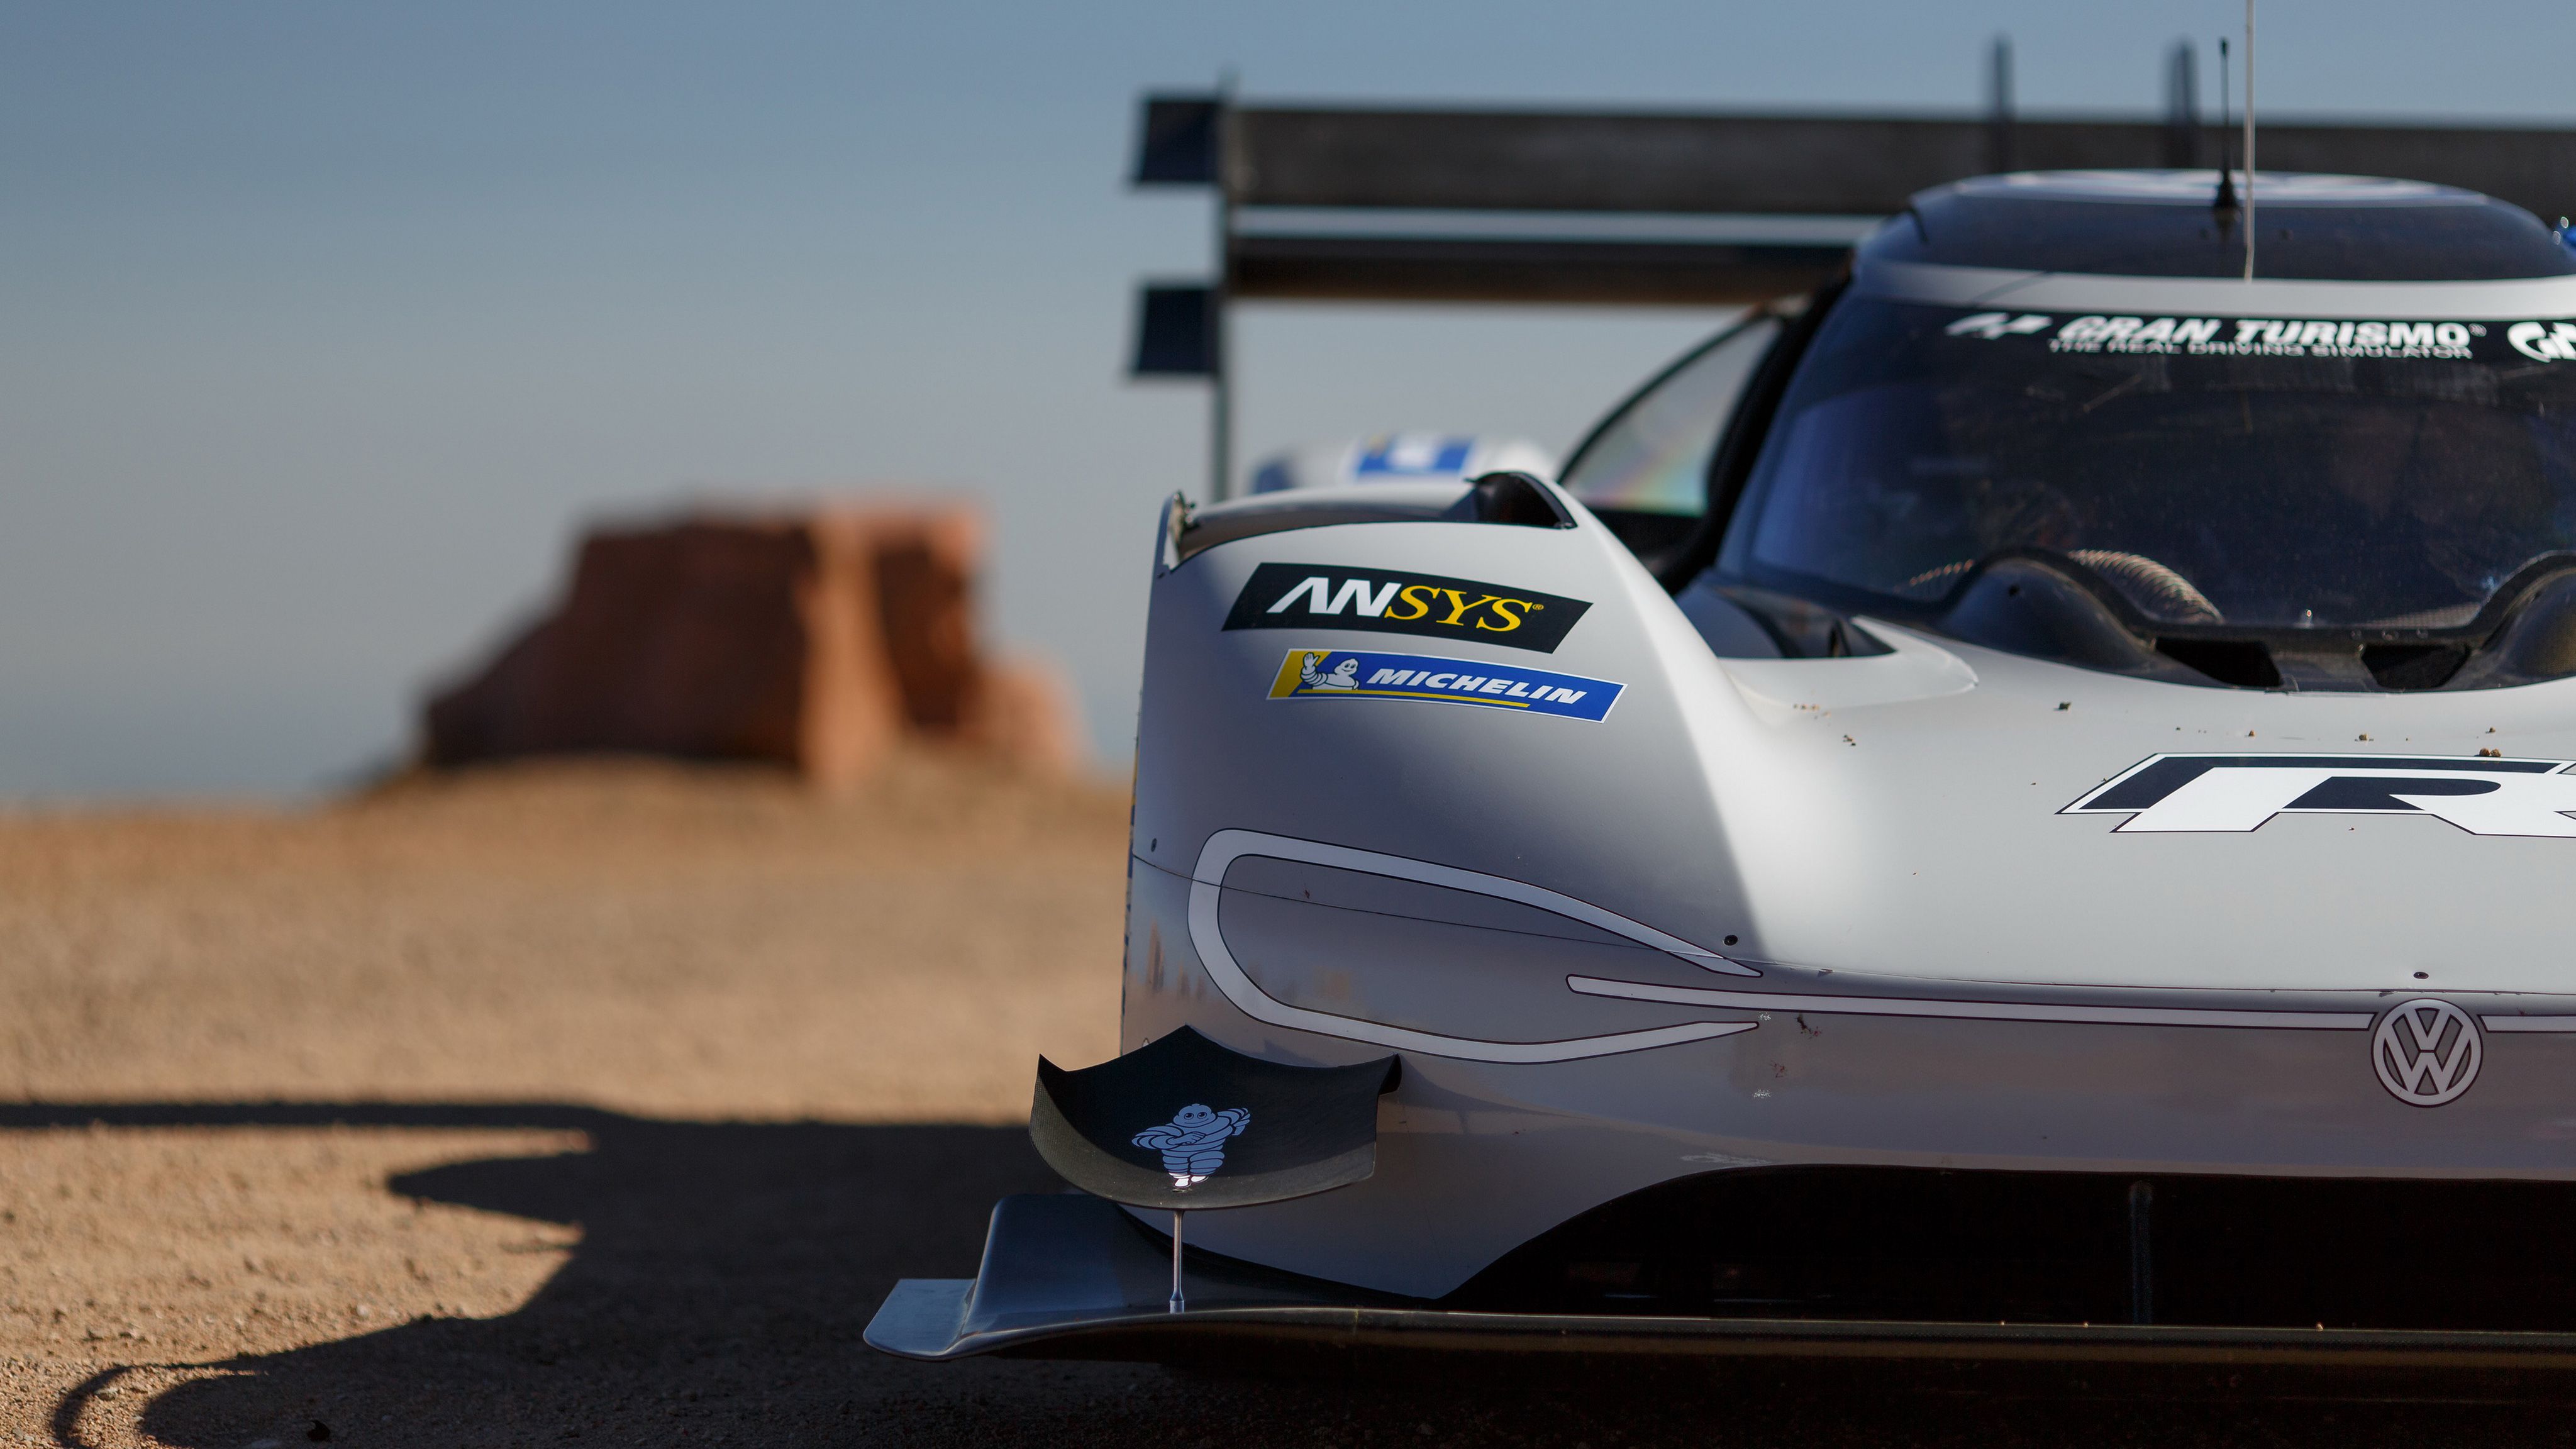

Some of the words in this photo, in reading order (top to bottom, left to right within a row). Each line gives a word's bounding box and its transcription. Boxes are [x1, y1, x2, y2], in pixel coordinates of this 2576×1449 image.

[2057, 315, 2222, 343] GRAN
[2234, 319, 2470, 347] TURISMO
[2107, 340, 2182, 354] REAL
[2187, 341, 2305, 356] DRIVING
[2311, 343, 2473, 359] SIMULATOR
[1367, 668, 1587, 705] MICHELIN
